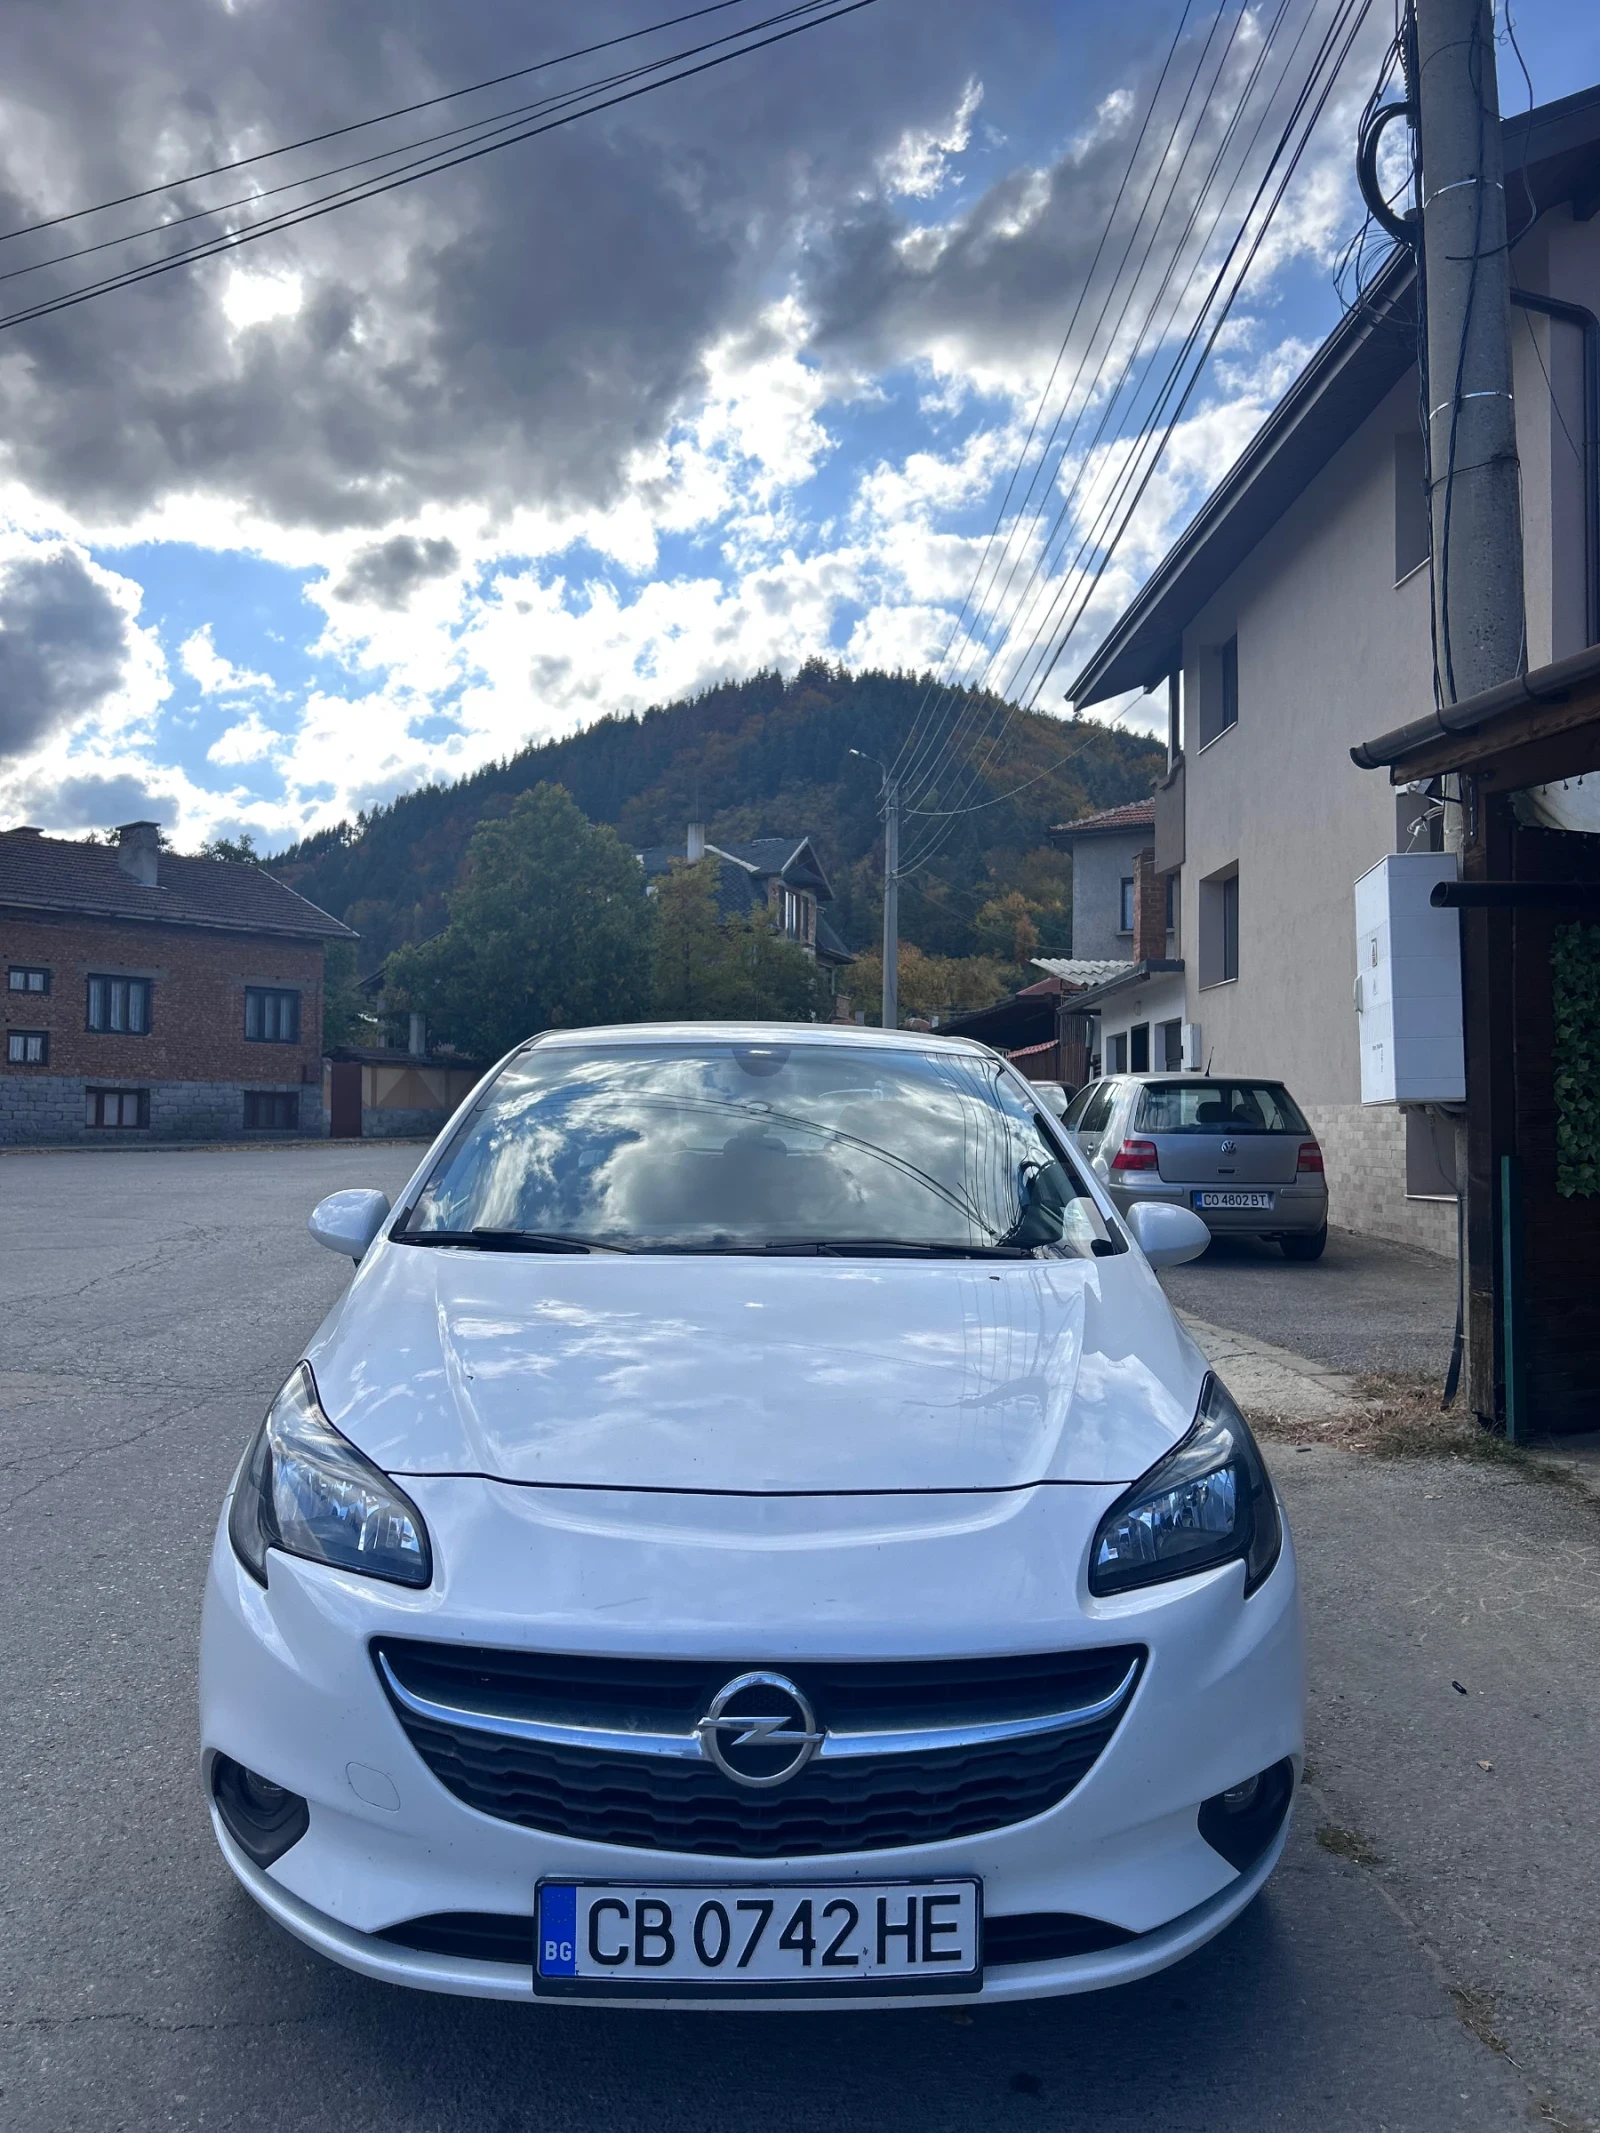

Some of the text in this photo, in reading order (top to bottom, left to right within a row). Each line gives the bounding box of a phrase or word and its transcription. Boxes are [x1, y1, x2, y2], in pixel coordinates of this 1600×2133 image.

[1203, 1194, 1219, 1206] CO
[1221, 1194, 1249, 1206] 4802
[1251, 1194, 1266, 1206] BT
[588, 1894, 962, 1968] CB 0742 HE
[545, 1940, 572, 1962] BG
